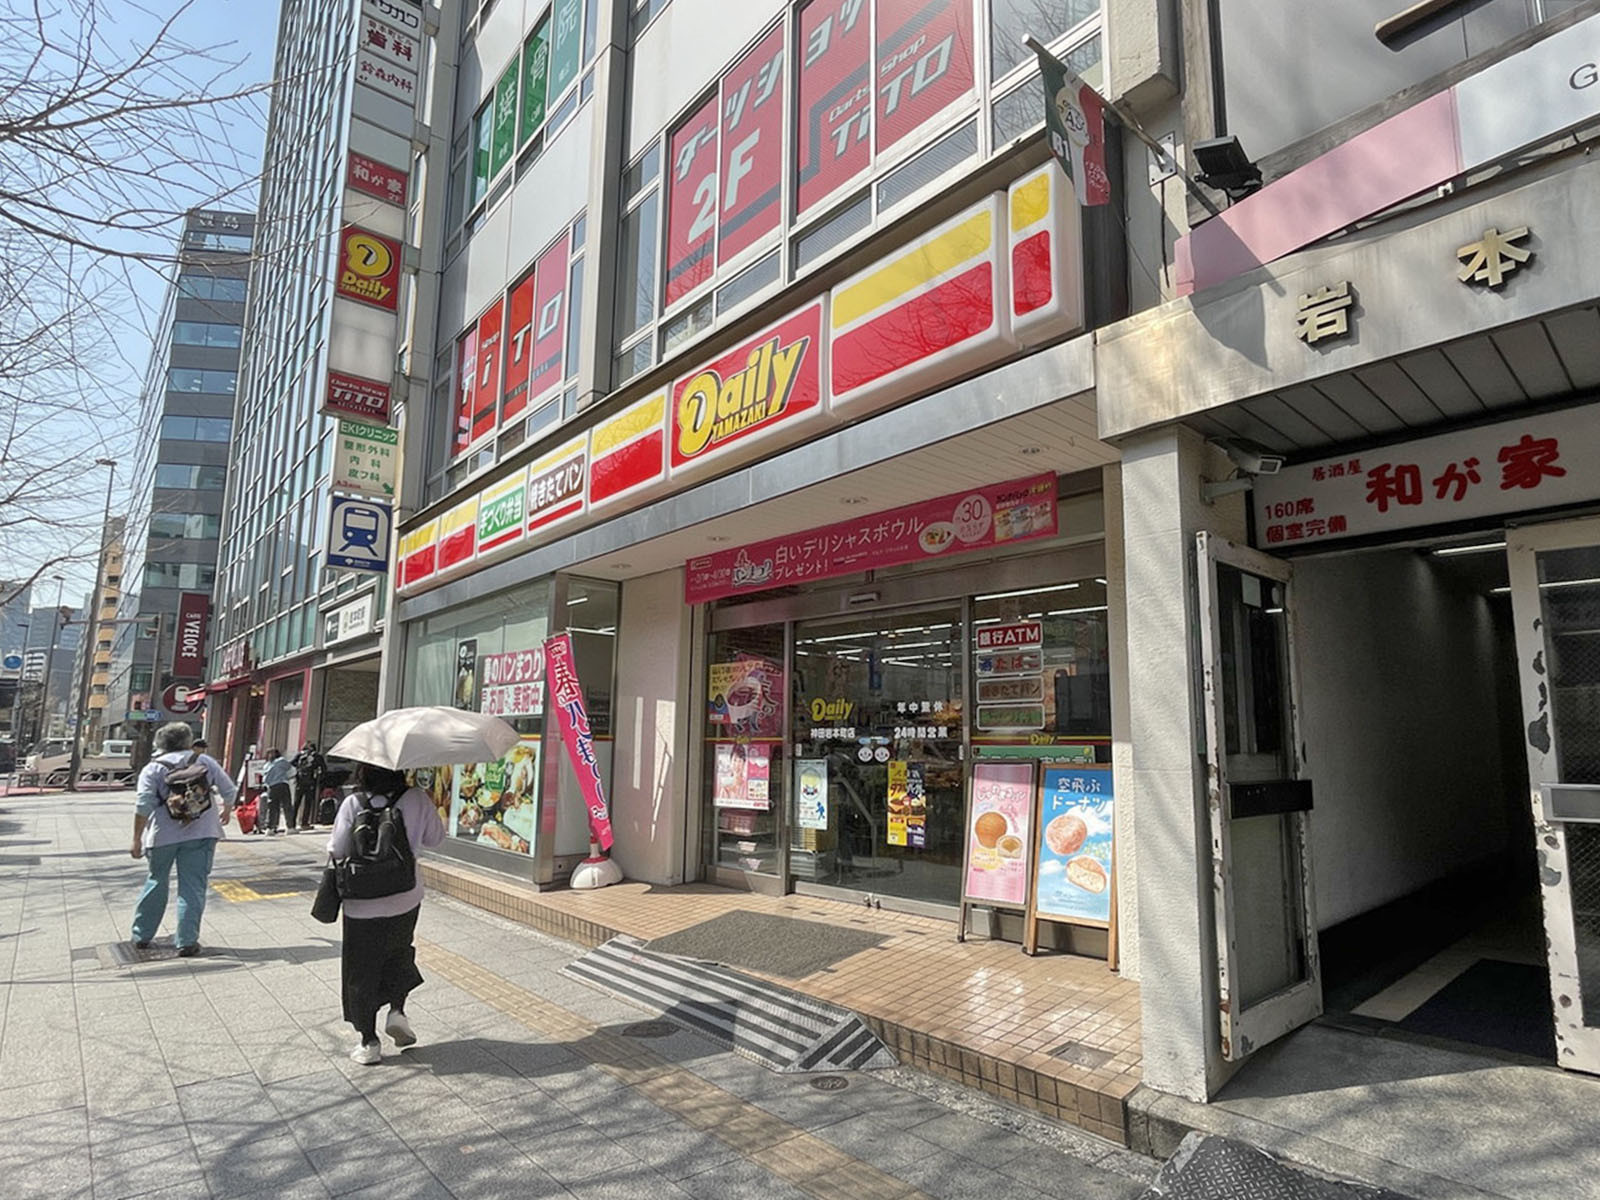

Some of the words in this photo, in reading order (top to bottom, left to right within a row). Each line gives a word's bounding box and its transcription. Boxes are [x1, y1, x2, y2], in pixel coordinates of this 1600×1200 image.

[687, 129, 760, 244] 2F
[342, 271, 391, 300] Daily
[678, 336, 810, 457] Daily
[340, 422, 397, 442] EKIクリニック
[713, 402, 766, 442] YAMAZAKI
[344, 440, 390, 458] 整形外科
[1311, 459, 1364, 481] 居酒屋
[1365, 434, 1567, 513] 和が家
[530, 463, 583, 511] 焼きたてパン
[961, 499, 983, 523] 30
[1264, 498, 1315, 520] 160席
[775, 516, 924, 565] 白いデリシャスボウル
[1265, 514, 1347, 544] 個室完備
[181, 620, 200, 659] VELOCE
[979, 627, 1039, 646] 銀行ATM
[484, 650, 543, 684] 春のパンまつり
[995, 655, 1040, 668] たばこ
[811, 698, 853, 722] Daily
[897, 700, 944, 714] 年中無休
[810, 727, 856, 739] 神田岩本町店
[893, 726, 948, 739] 24時間営業
[1057, 777, 1101, 793] 空飛ぶ
[1052, 795, 1106, 813] ドーナツ
